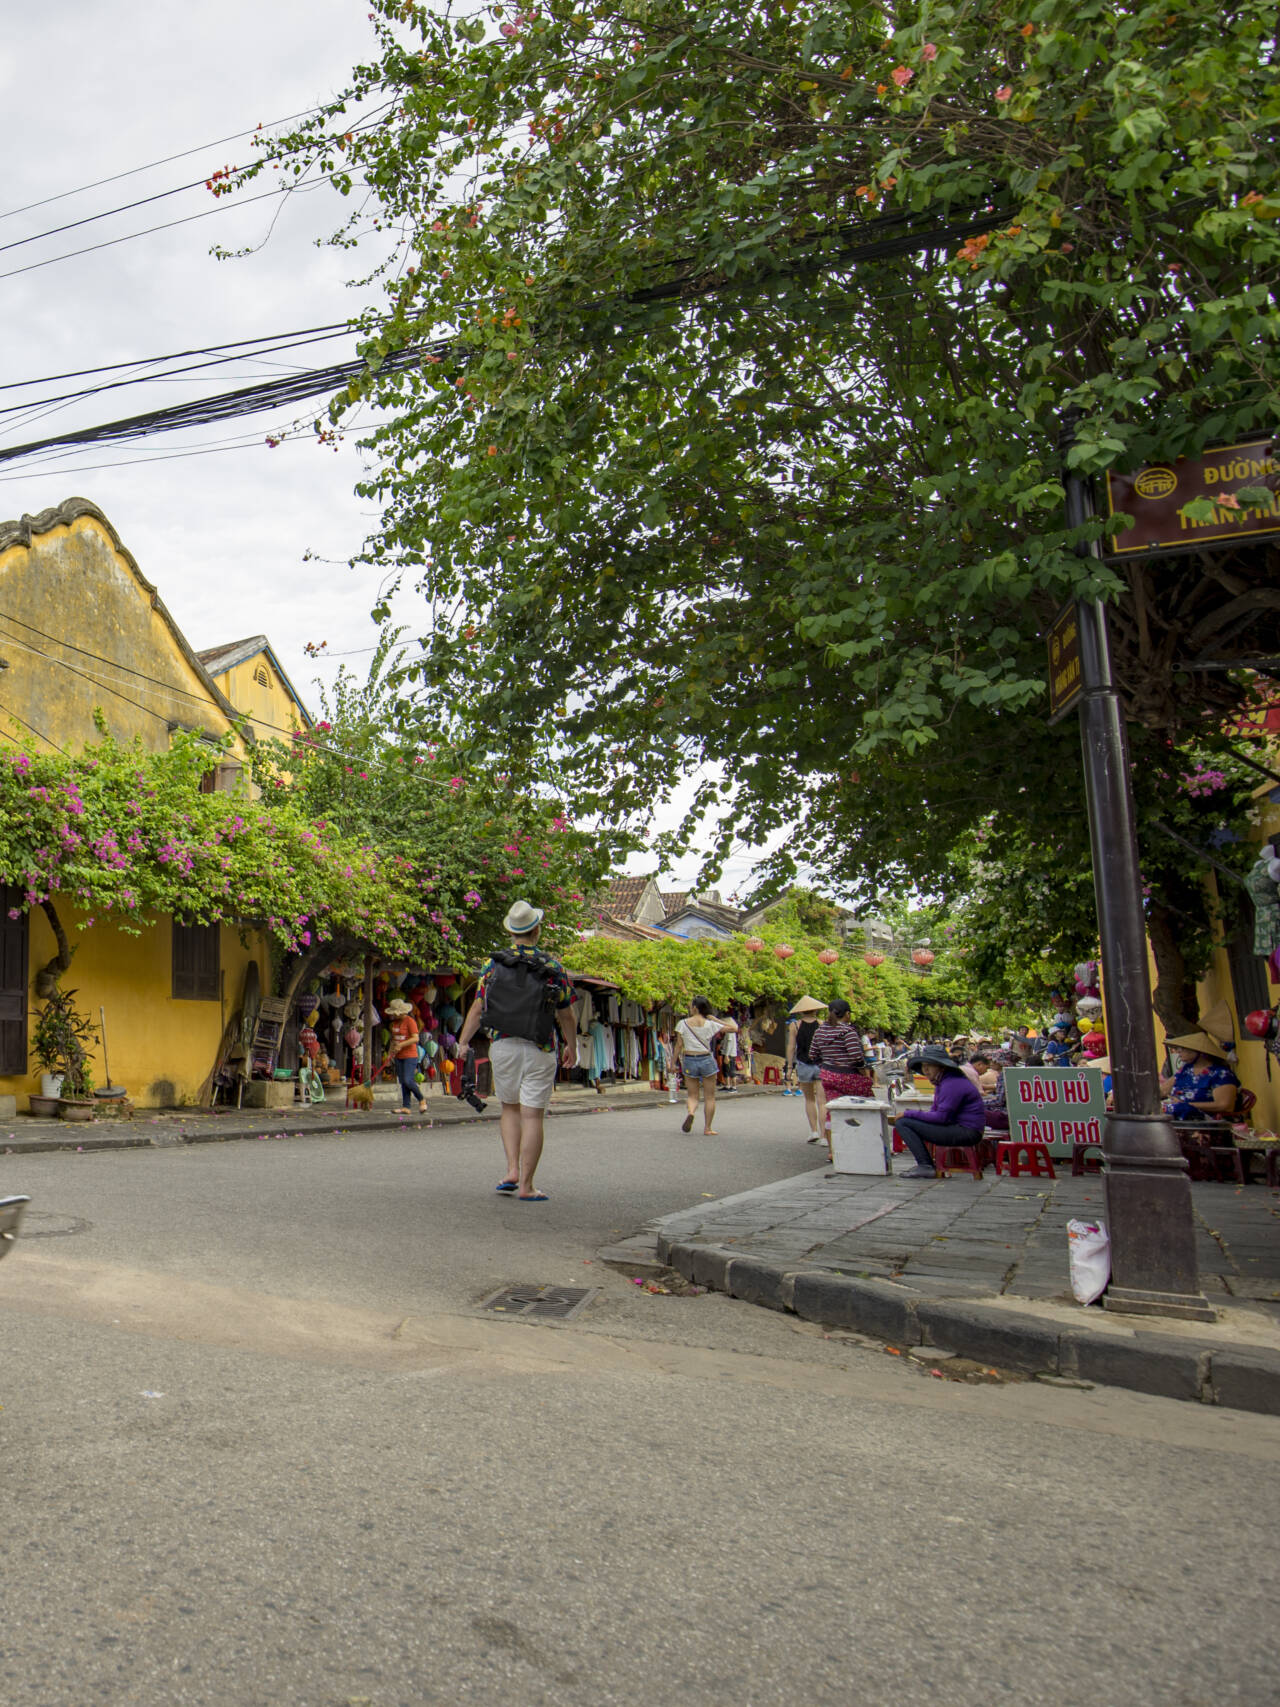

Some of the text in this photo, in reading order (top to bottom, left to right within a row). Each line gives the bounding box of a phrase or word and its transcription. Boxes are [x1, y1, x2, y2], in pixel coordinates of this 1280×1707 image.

[1019, 1072, 1091, 1110] ĐẬU HỦ
[1018, 1115, 1101, 1144] TÀU PHỚ
